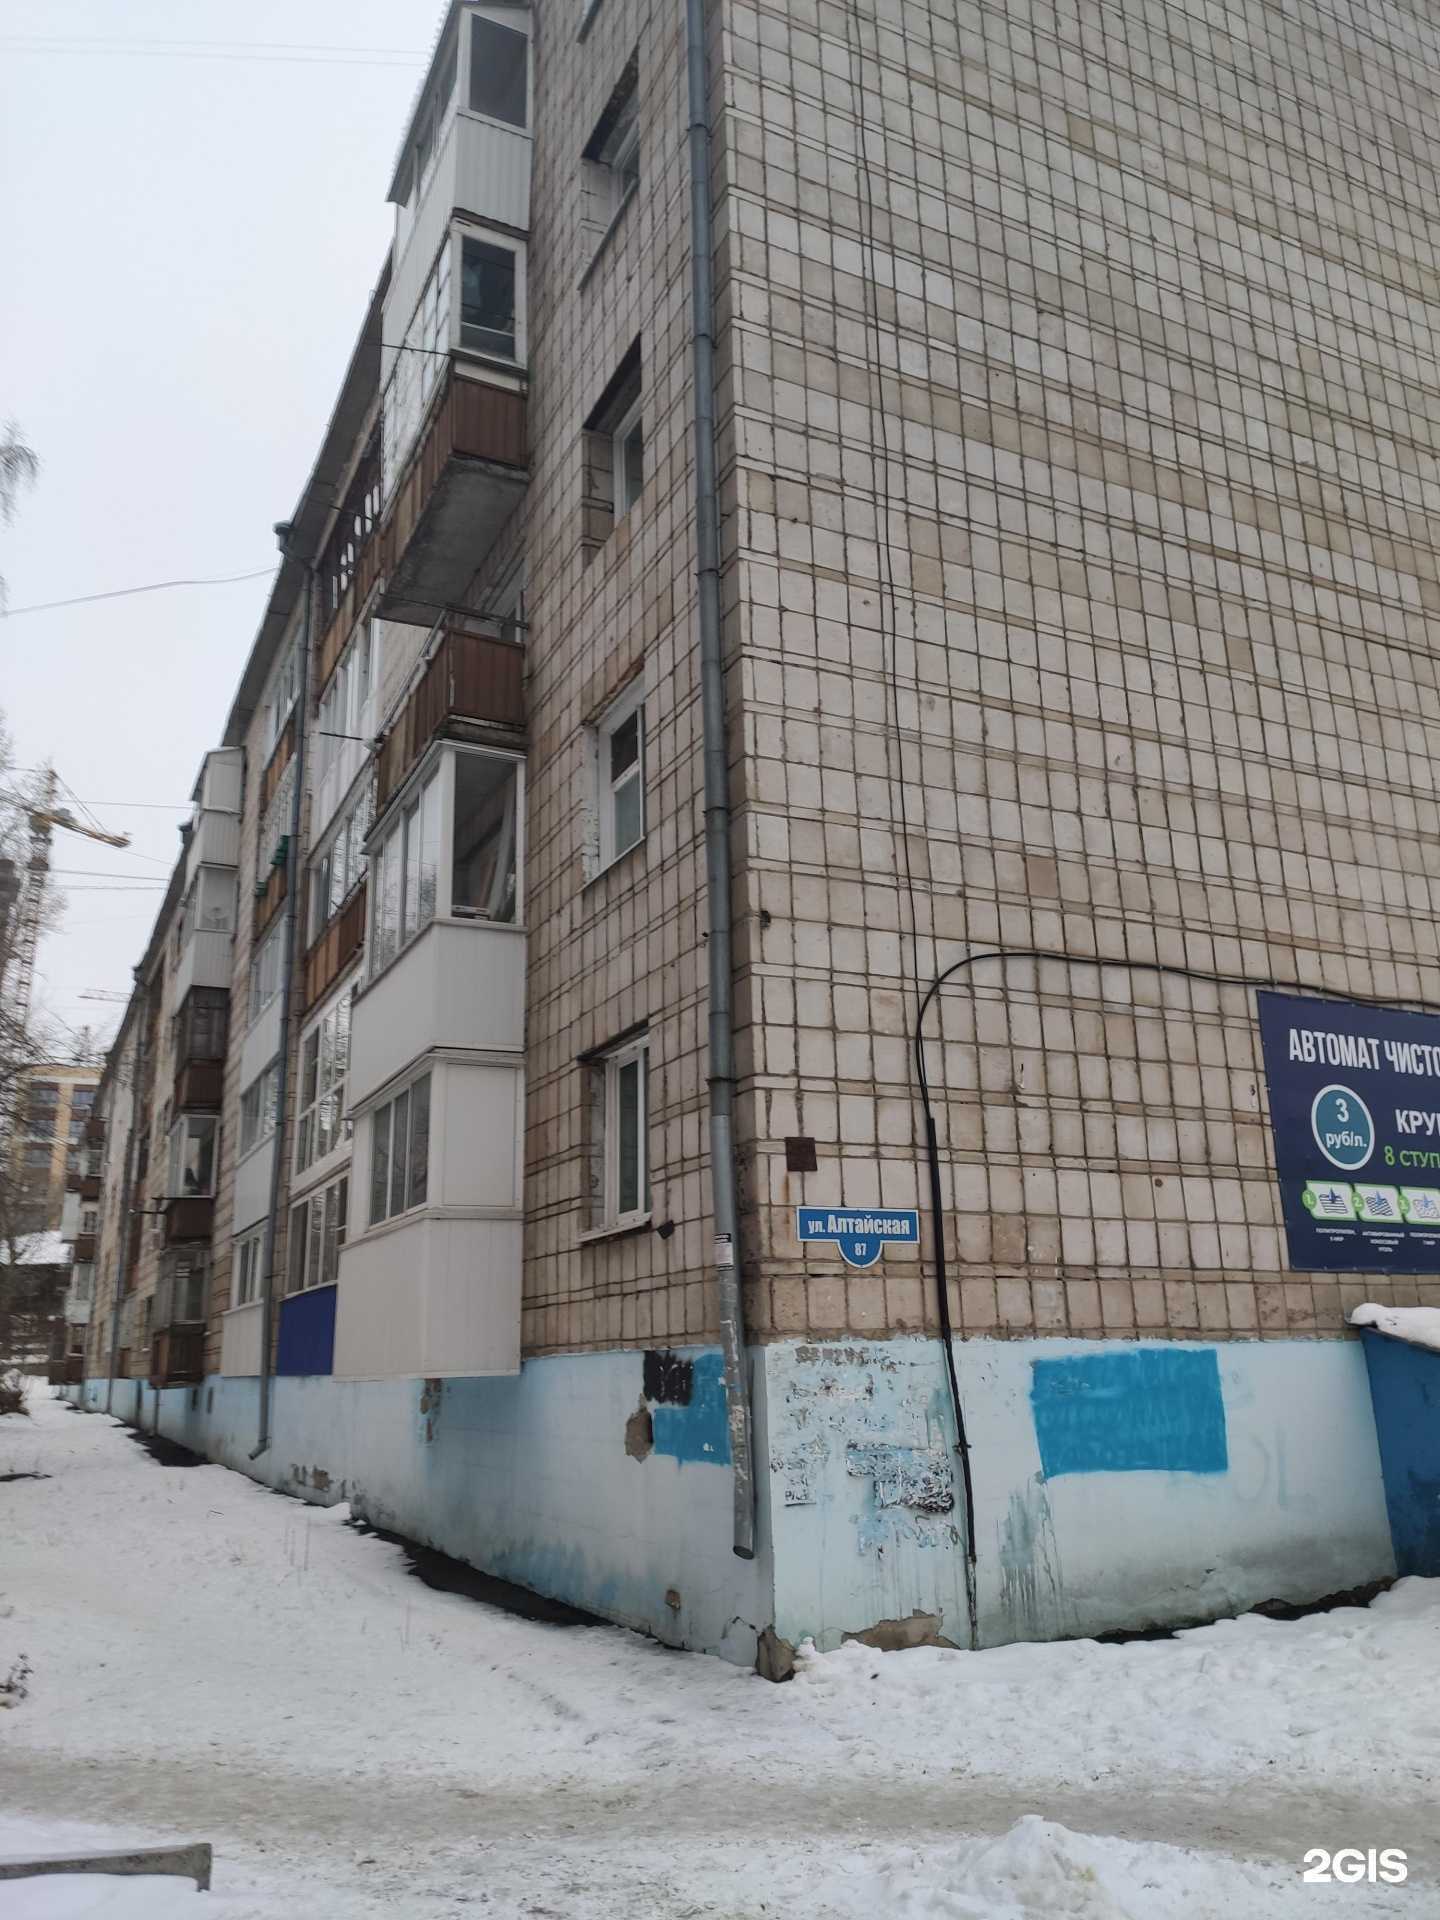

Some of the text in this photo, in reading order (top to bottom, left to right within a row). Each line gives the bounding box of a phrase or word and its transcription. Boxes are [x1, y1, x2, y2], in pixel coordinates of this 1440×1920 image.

[1289, 1028, 1380, 1070] АВТОМАТ
[1335, 1098, 1349, 1122] 3
[1384, 1145, 1395, 1166] 8
[808, 1214, 910, 1235] ул. Алтайская
[854, 1243, 867, 1256] 87
